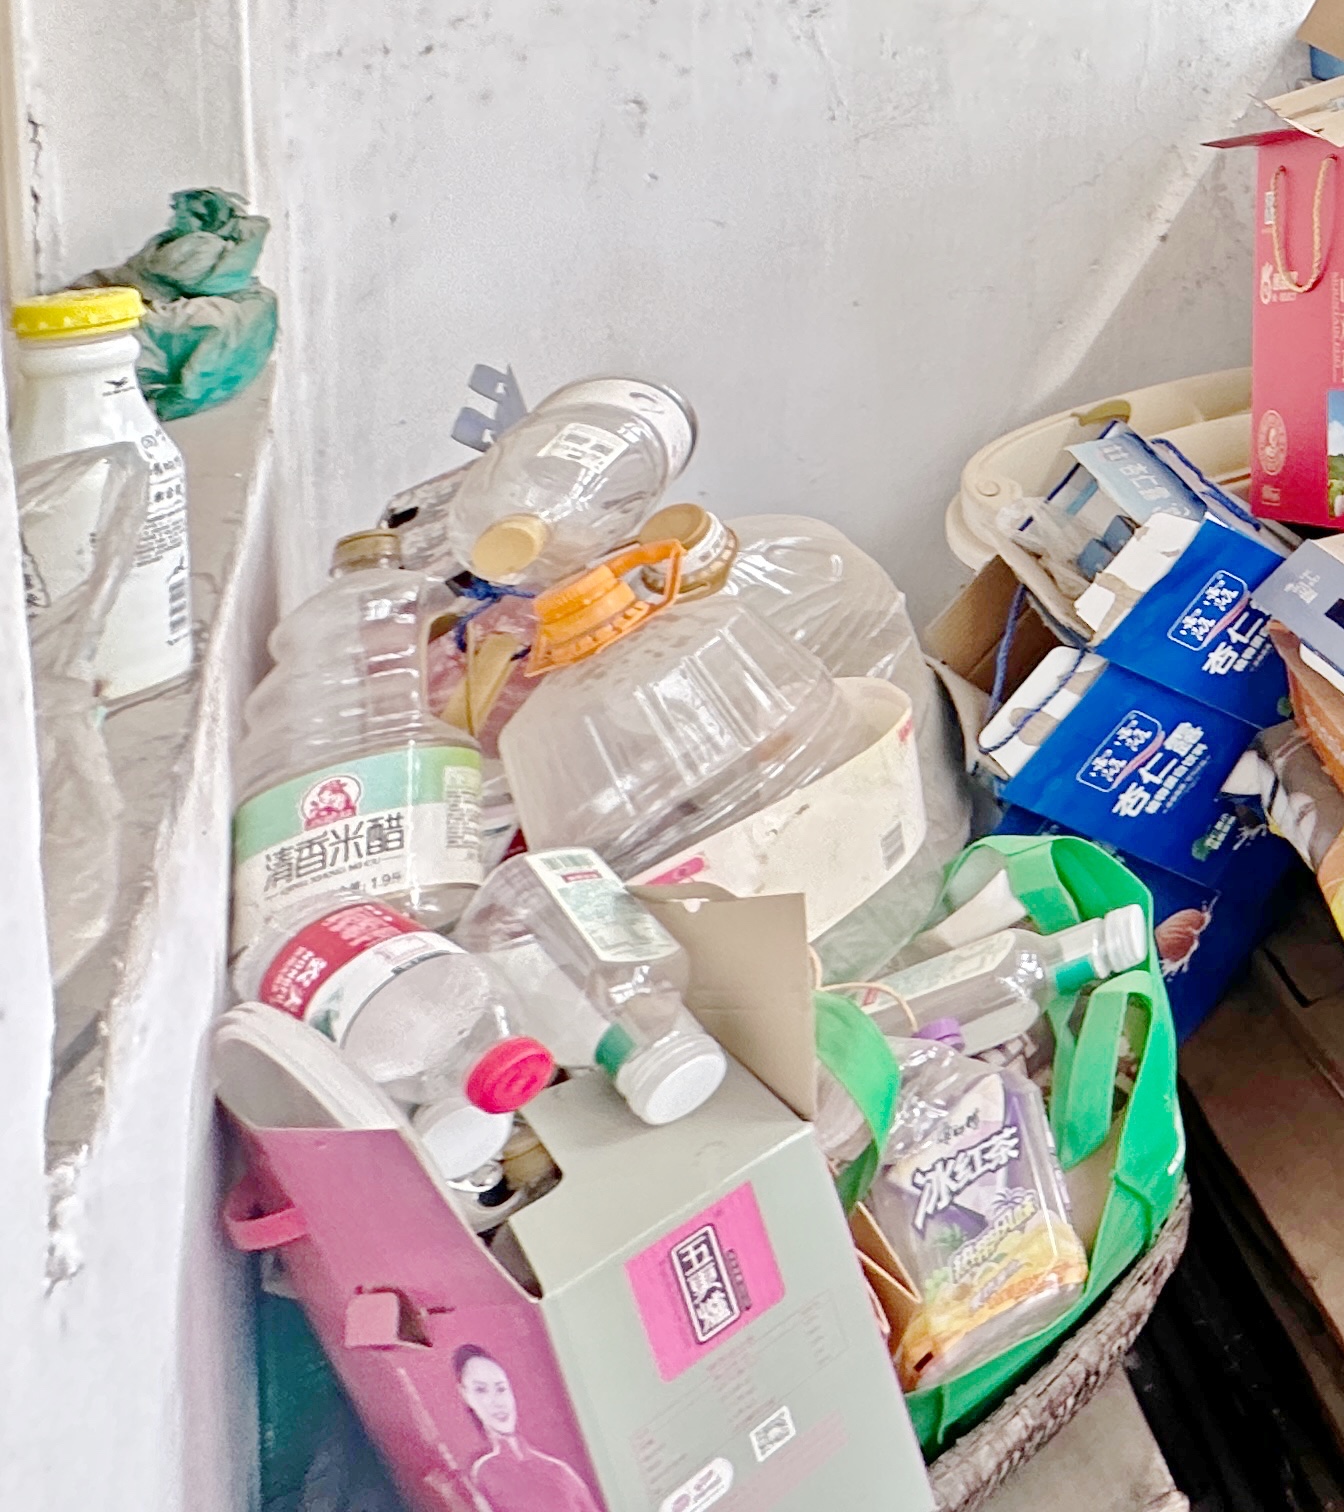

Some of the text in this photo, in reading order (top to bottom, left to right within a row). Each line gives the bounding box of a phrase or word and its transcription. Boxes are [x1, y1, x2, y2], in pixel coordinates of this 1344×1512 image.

[1202, 598, 1271, 675] 杏仁
[264, 812, 405, 892] 清香米醋
[913, 1124, 1021, 1232] 冰红茶
